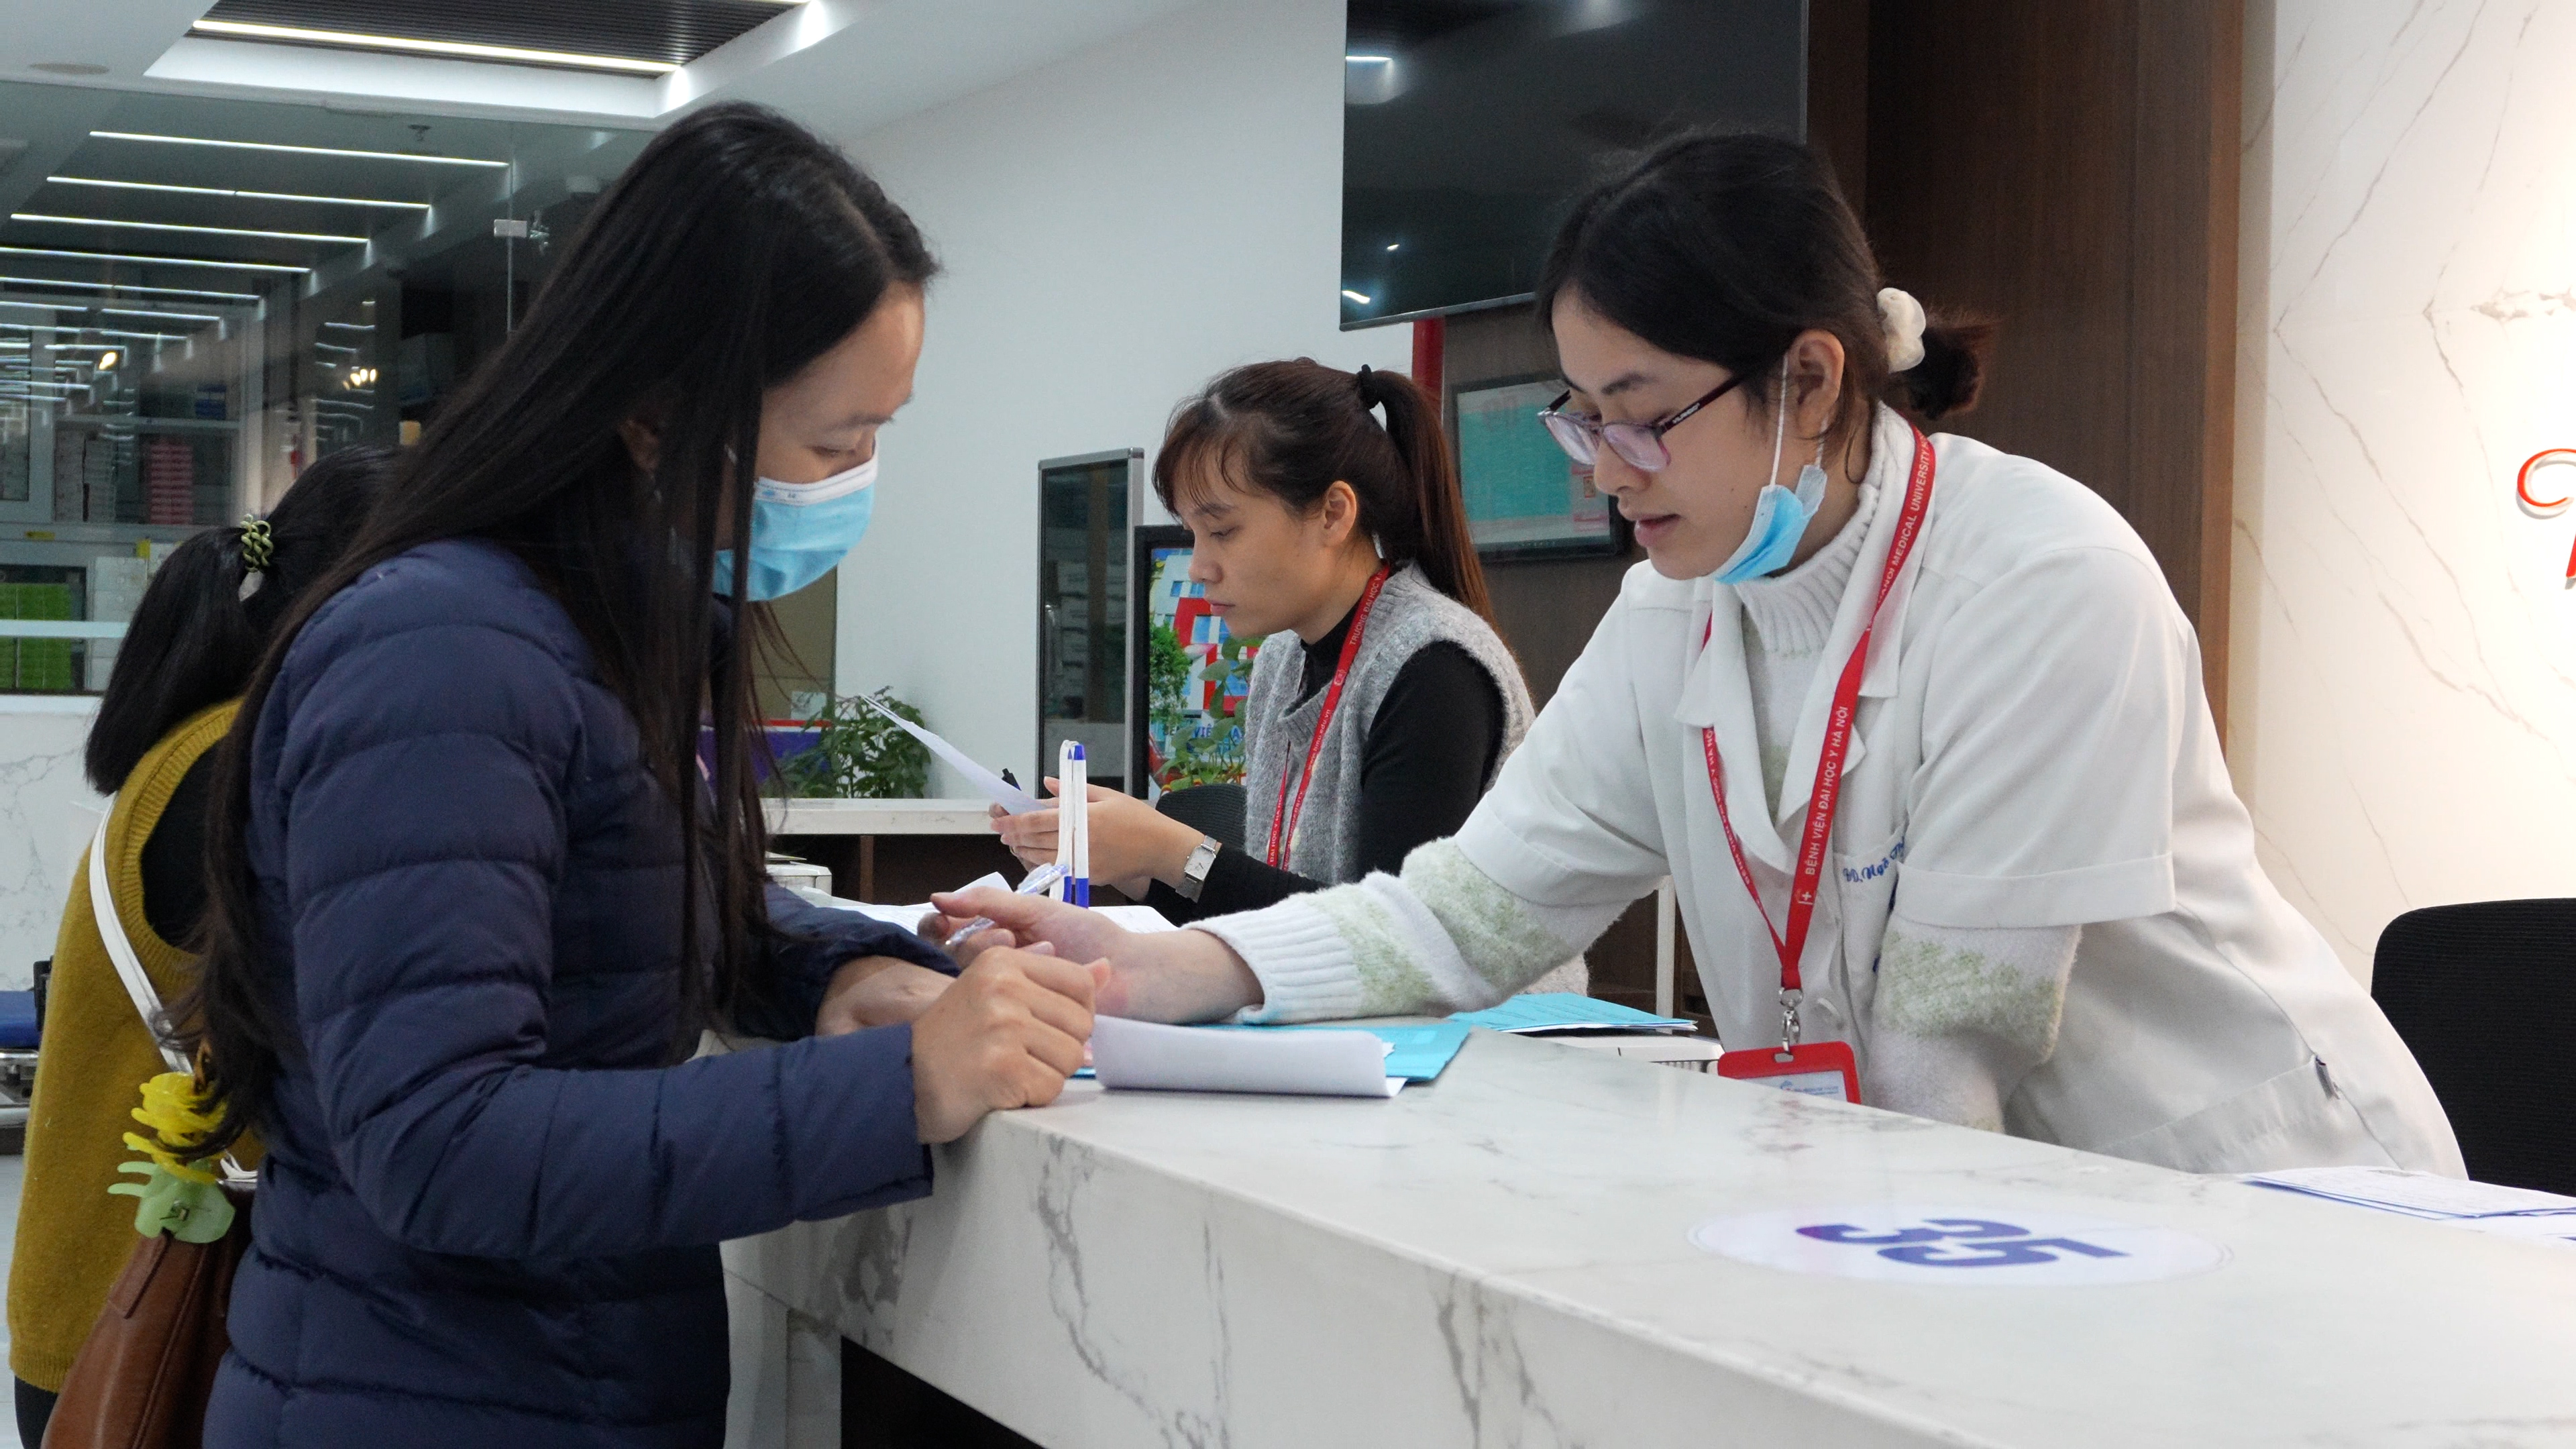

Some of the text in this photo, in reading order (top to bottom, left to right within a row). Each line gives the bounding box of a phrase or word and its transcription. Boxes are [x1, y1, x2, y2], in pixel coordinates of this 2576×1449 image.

[1892, 515, 1917, 566] MEDICAL
[1910, 450, 1930, 511] UNIVERSITY
[1835, 706, 1849, 727] NỘI
[1831, 731, 1843, 747] HÀ
[1823, 761, 1837, 786] HỌC
[1818, 788, 1832, 810] ĐẠI
[1812, 812, 1827, 839] VIỆN
[1804, 842, 1820, 875] BỆNH
[1795, 1218, 2132, 1268] 35
